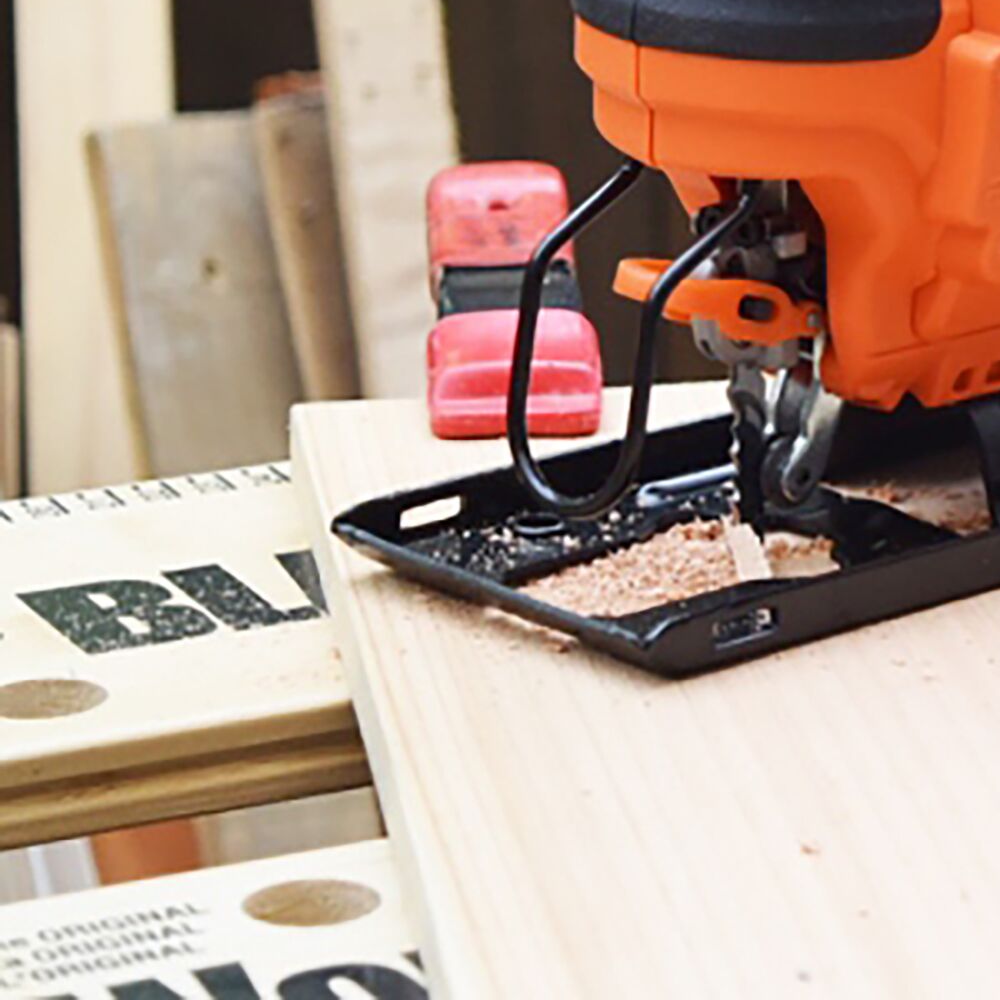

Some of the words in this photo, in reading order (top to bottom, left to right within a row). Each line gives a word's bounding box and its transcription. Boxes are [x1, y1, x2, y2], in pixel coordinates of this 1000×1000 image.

[16, 548, 330, 656] BL
[31, 923, 205, 962] ORIGINAL
[37, 902, 209, 943] ORIGINAL
